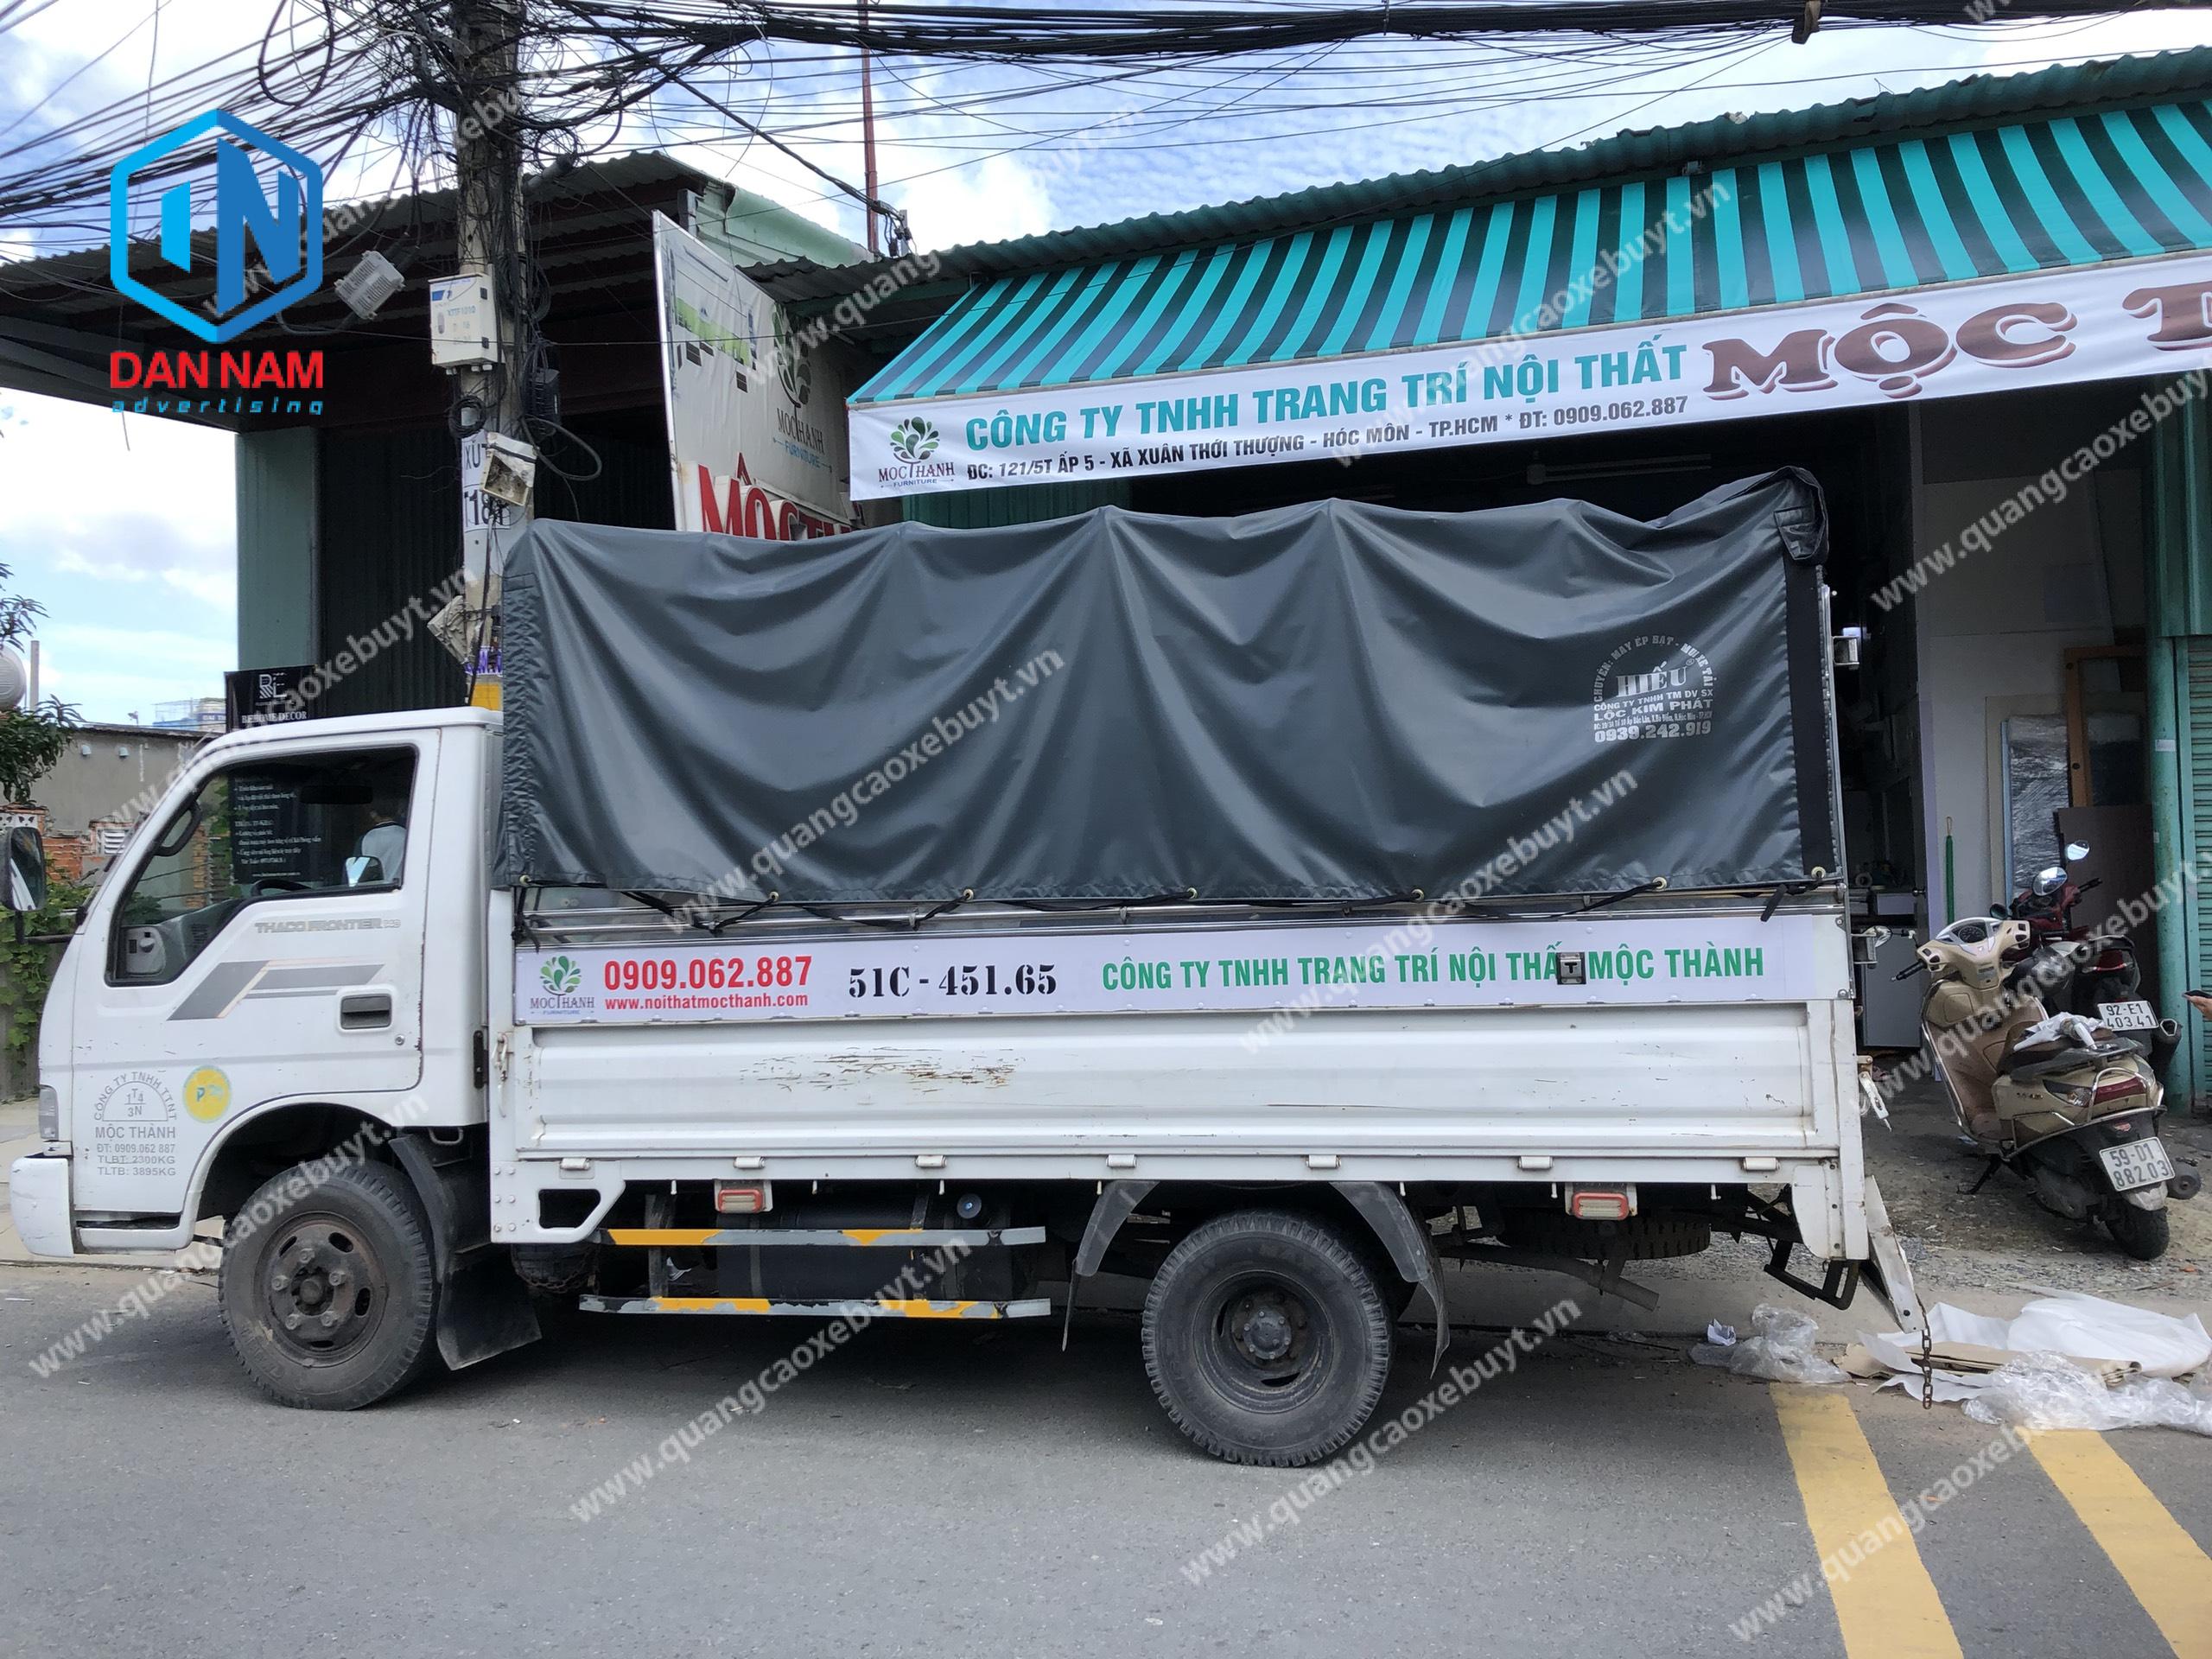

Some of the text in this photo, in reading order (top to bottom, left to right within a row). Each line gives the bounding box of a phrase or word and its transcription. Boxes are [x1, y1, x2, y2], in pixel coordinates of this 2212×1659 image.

[1702, 302, 2077, 401] MỘC
[966, 334, 1688, 451] CÔNG TY TNHH TRANG TRÍ NỘI THẤT
[967, 463, 993, 480] ĐC:
[1000, 459, 1052, 477] 121/5T
[1058, 451, 1079, 474] ẤP
[1084, 455, 1094, 471] 5
[1110, 447, 1134, 469] XÃ
[1139, 442, 1184, 467] XUÂN
[1189, 436, 1228, 461] THỚI
[1234, 435, 1304, 457] THƯỢNG
[1323, 428, 1359, 448] HÓC
[1366, 423, 1409, 443] MÔN
[1429, 415, 1498, 438] TP.HCM
[1519, 410, 1547, 429] ĐT:
[1554, 396, 1688, 426] 0909.062.887
[893, 479, 938, 487] FURNITURE
[1611, 641, 1632, 660] MAY
[1594, 702, 1620, 711] CÔNG
[1637, 694, 1663, 704] TNHH
[1701, 689, 1713, 697] SX
[1594, 697, 1713, 721] LỘC KIM PHÁT
[604, 956, 812, 990] 0909.062.887
[1103, 941, 1764, 990] CÔNG TY TNHH TRANG TRÍ NỘI THẤ MỘC THÀNH
[849, 966, 910, 998] 51C
[938, 964, 1057, 996] 451.65
[605, 992, 808, 1012] www.noithatmocthanh.com
[2106, 1003, 2144, 1016] 92-E1
[2107, 1015, 2153, 1029] 403.41
[113, 1073, 128, 1086] TY
[131, 1071, 162, 1089] TNHH
[95, 1122, 176, 1141] MỘC THÀNH
[97, 1143, 112, 1154] ĐT:
[159, 1143, 176, 1153] 887
[2109, 1143, 2156, 1166] 59-D1
[132, 1154, 175, 1165] 2300KG
[97, 1166, 176, 1176] TLTB: 3895KG
[2113, 1160, 2170, 1187] 882.03
